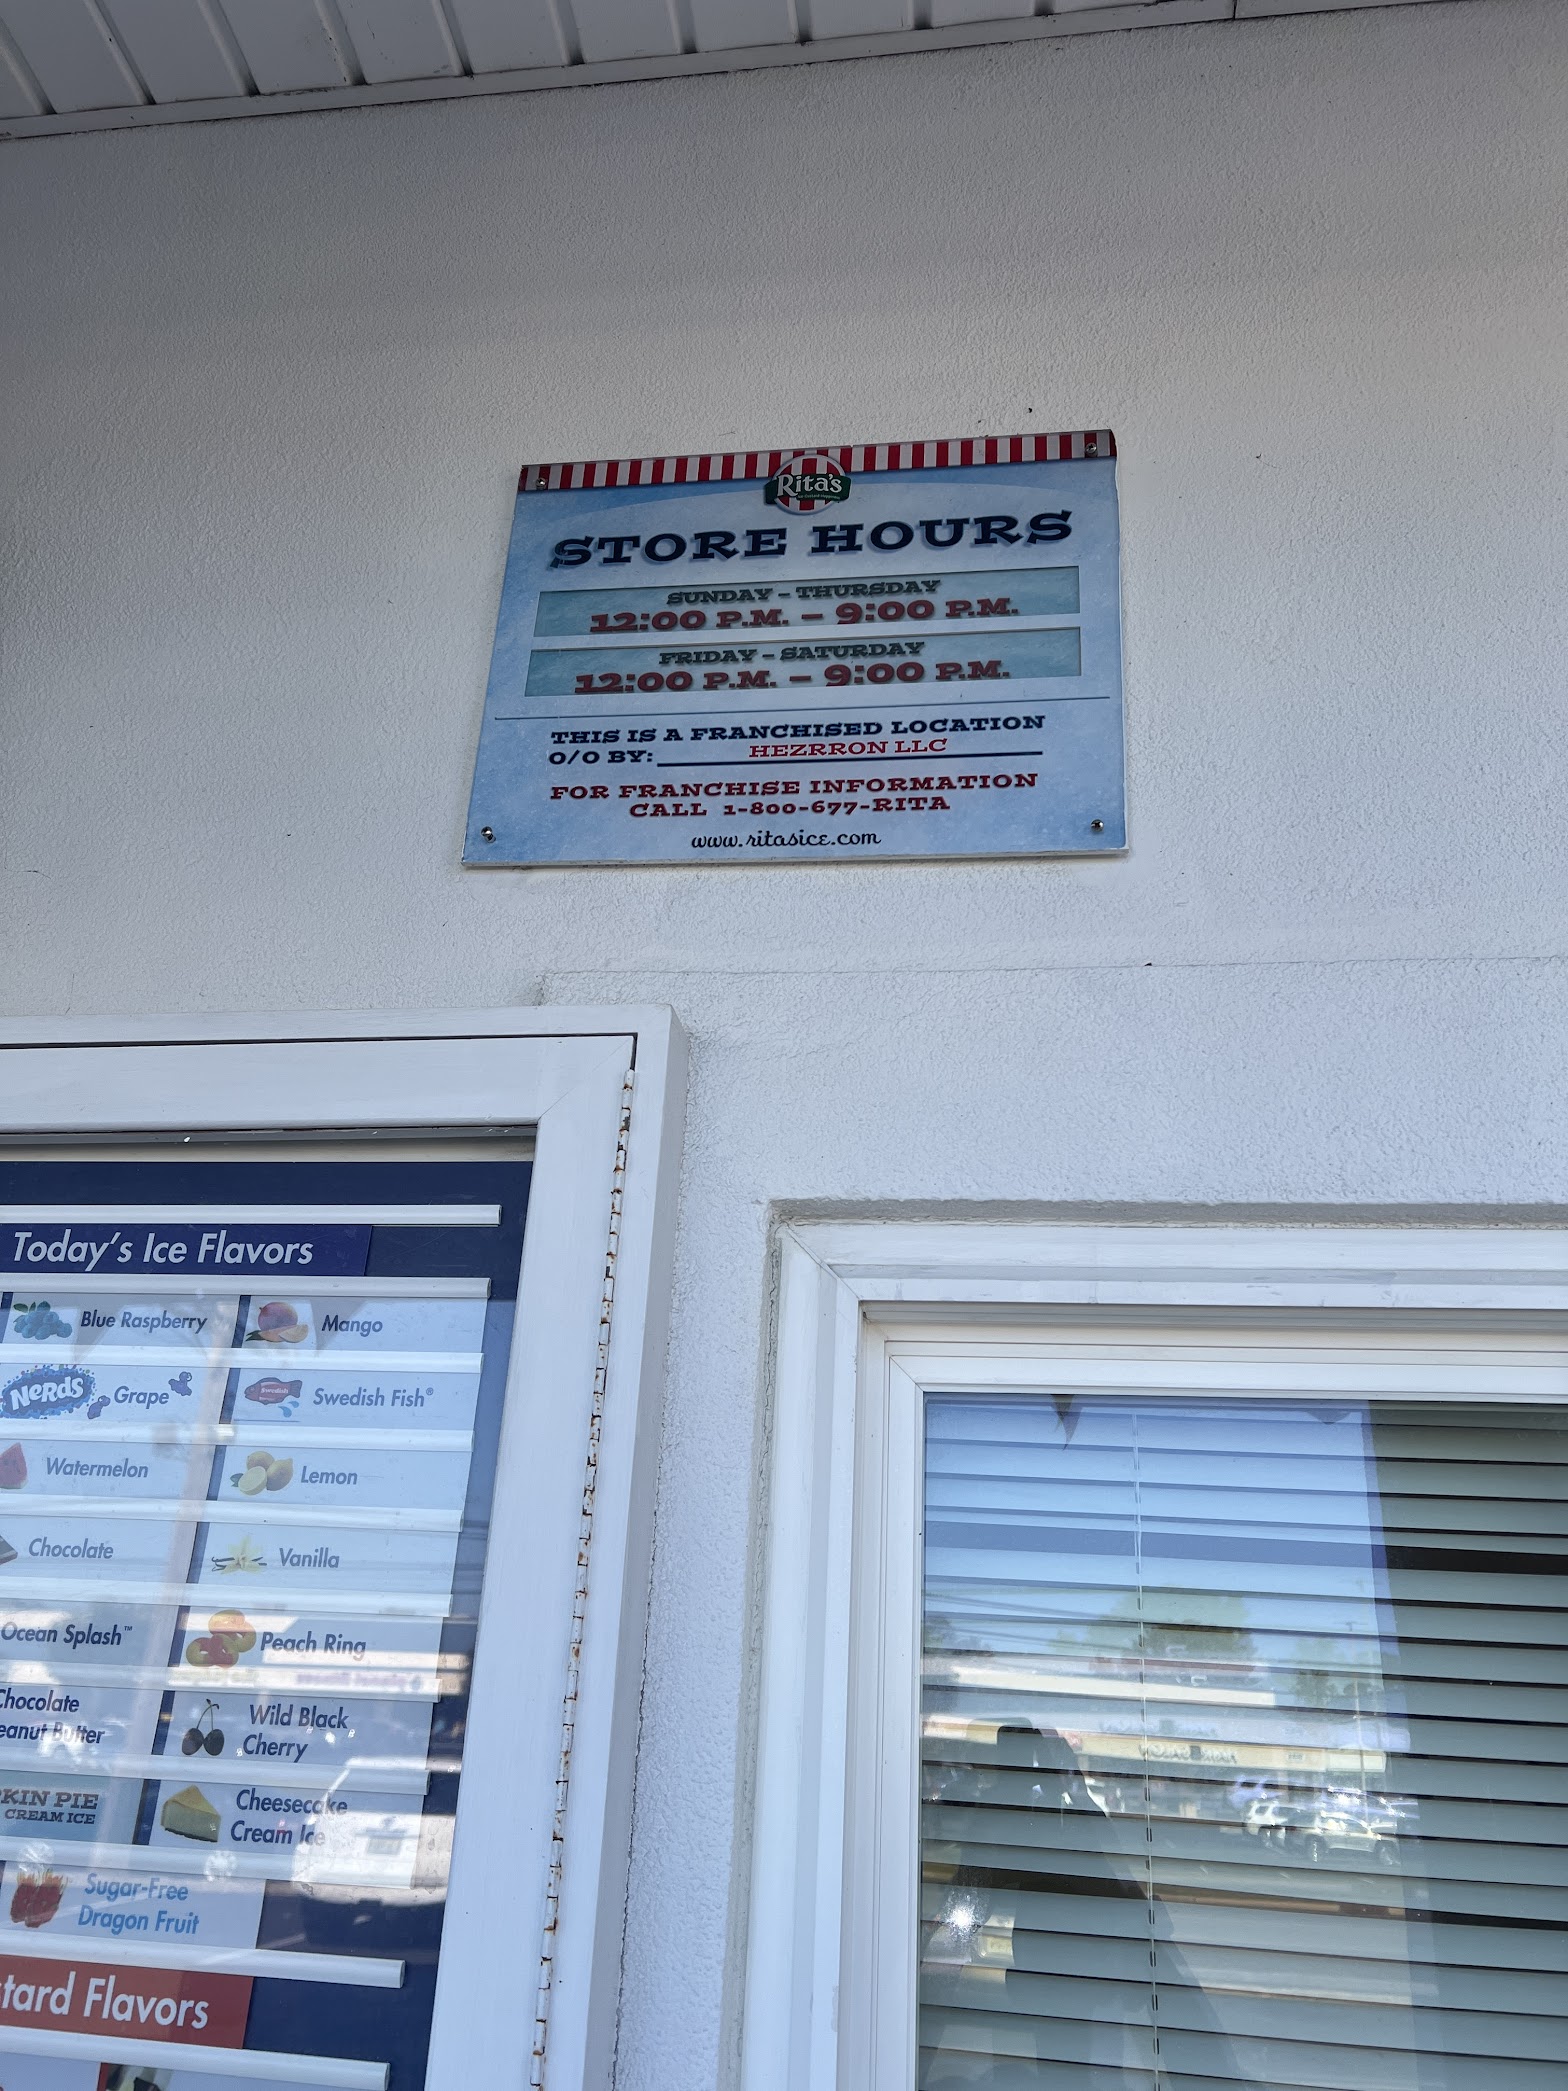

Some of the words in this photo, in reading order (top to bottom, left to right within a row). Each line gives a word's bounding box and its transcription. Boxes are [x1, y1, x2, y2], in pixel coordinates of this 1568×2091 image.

[777, 473, 843, 497] Rita's
[550, 527, 788, 568] STORE
[811, 510, 1073, 553] HOURS
[666, 587, 773, 605] SUNDAY
[795, 580, 941, 599] THURSDAY
[590, 610, 706, 632] 12:00
[716, 609, 788, 628] P.M.
[835, 600, 935, 625] 9:00
[945, 598, 1019, 618] P.M.
[659, 648, 758, 665] FRIDAY
[779, 641, 925, 661] SATURDAY
[575, 671, 693, 693] 12:00
[703, 670, 777, 689] P.M.
[824, 662, 925, 687] 9:00
[935, 660, 1010, 680] P.M.
[551, 728, 620, 744] THIS
[627, 728, 657, 743] IS
[663, 728, 683, 742] A
[690, 722, 883, 741] FRANCHISED
[891, 715, 1046, 734] LOCATION
[608, 750, 654, 763] BY:
[749, 741, 889, 758] HEZRRON
[895, 738, 948, 753] LLC
[550, 785, 610, 800] FOR
[618, 781, 800, 799] FRANCHISE
[810, 773, 1039, 794] INFORMATION
[629, 803, 708, 817] CALL
[724, 796, 951, 816] 1-800-677-RITA
[691, 829, 882, 848] www.ritasice.com
[13, 1228, 133, 1271] Today's
[143, 1232, 188, 1264] Ice
[197, 1230, 314, 1264] Flavors
[80, 1309, 116, 1328] Blue
[120, 1311, 208, 1334] Raspberry
[321, 1314, 383, 1337] Mango
[113, 1386, 169, 1409] Grape
[313, 1387, 385, 1406] Swedish
[46, 1457, 149, 1478] Watermelon
[301, 1465, 358, 1485] Lemon
[28, 1536, 114, 1559] Chocolate
[279, 1547, 340, 1568] Vanilla
[1, 1622, 58, 1643] Ocean
[261, 1631, 317, 1651] Peach
[324, 1634, 367, 1661] Ring
[249, 1704, 293, 1726] Wild
[298, 1706, 350, 1729] Black
[52, 1721, 105, 1744] Butter
[242, 1733, 309, 1763] Cherry
[0, 1788, 50, 1806] KIN
[53, 1792, 99, 1810] PIE
[236, 1788, 348, 1815] Cheesecake
[4, 1808, 65, 1823] CREAM
[66, 1812, 96, 1825] ICE
[230, 1820, 293, 1845] Cream
[299, 1825, 326, 1846] Ice
[84, 1873, 189, 1902] Sugar-Free
[78, 1904, 149, 1935] Dragon
[155, 1911, 200, 1935] Fruit
[0, 1971, 77, 2016] tard
[83, 1974, 210, 2030] Flavors
